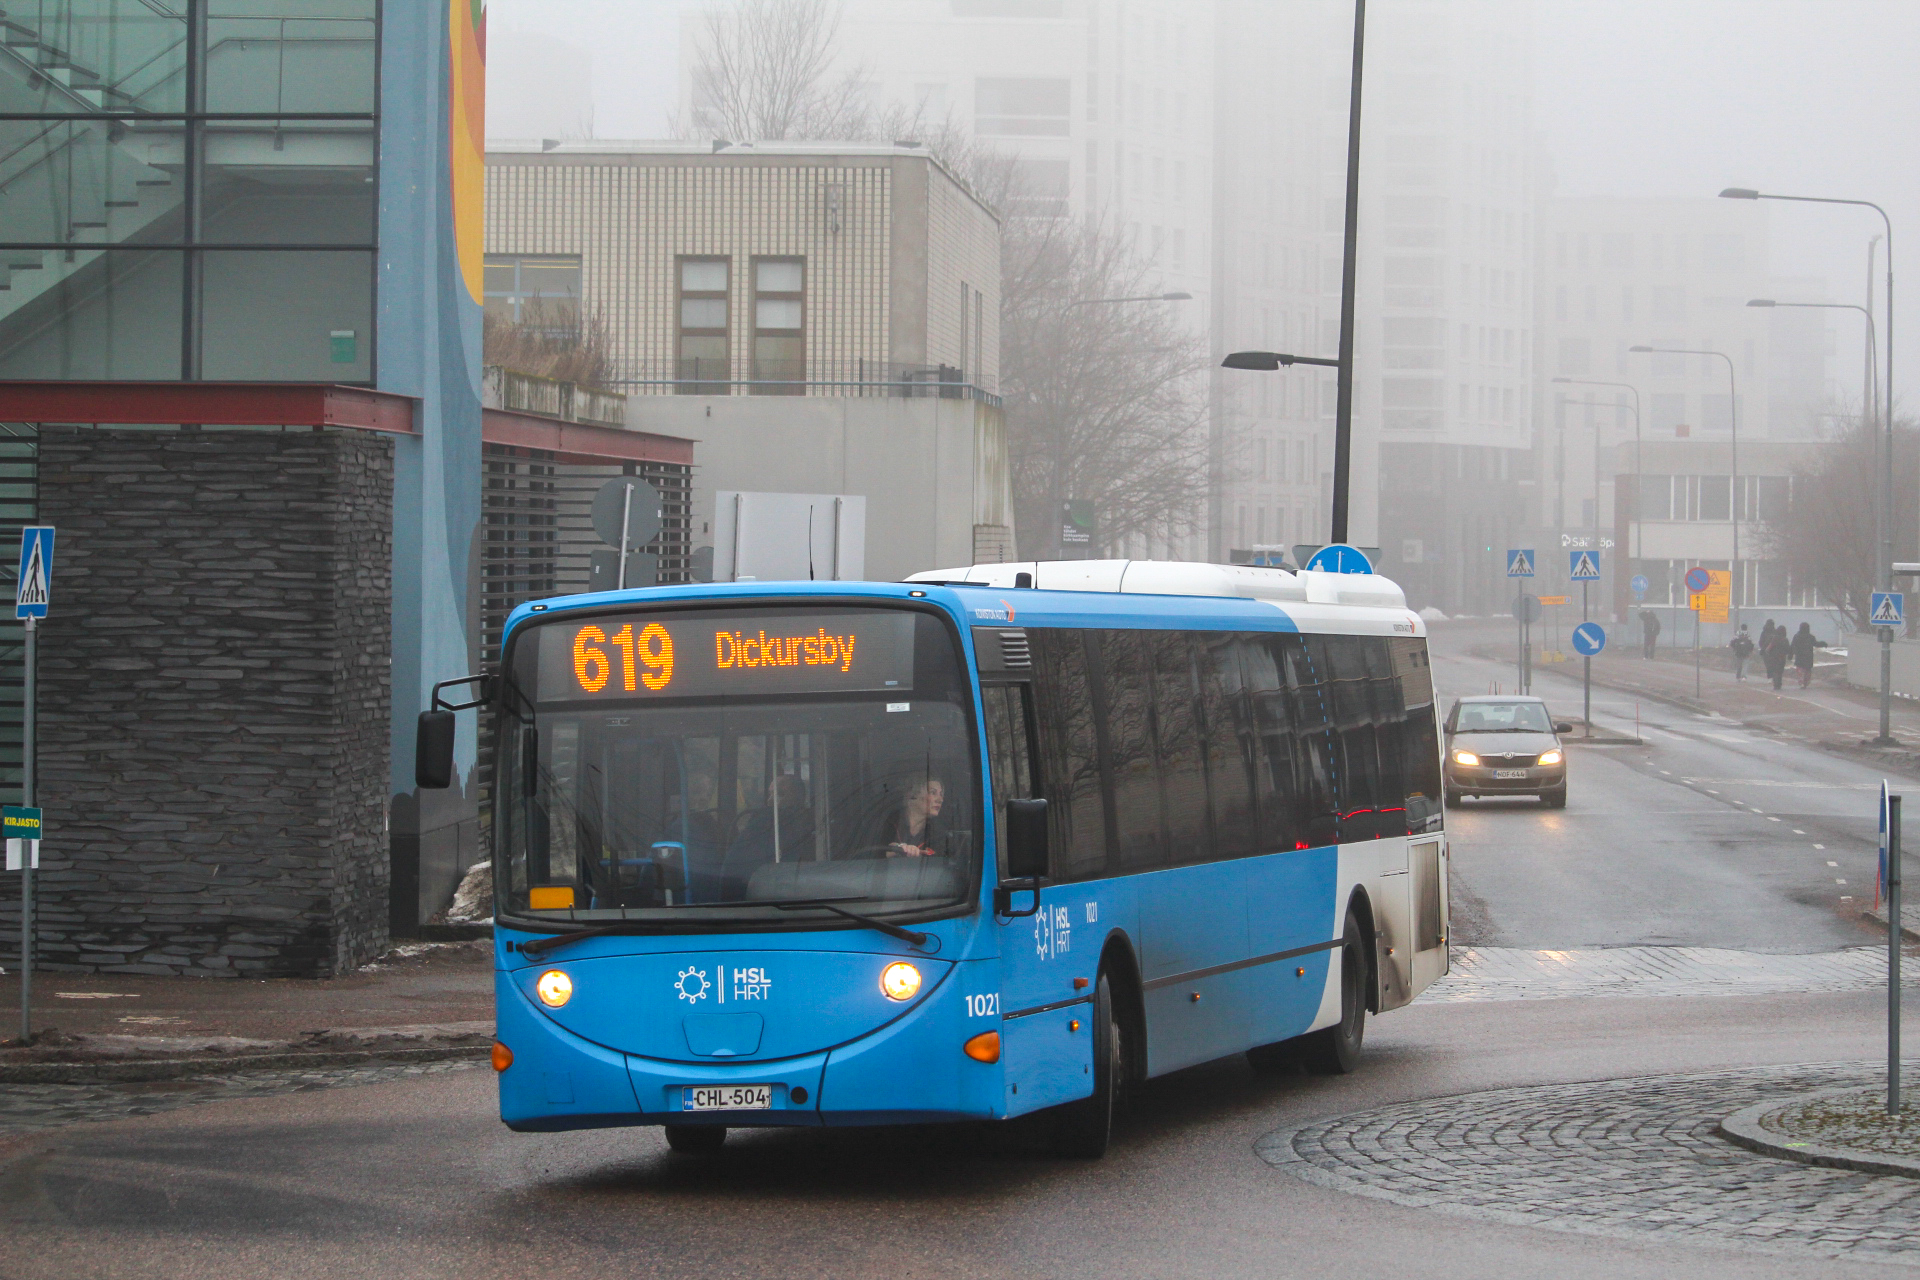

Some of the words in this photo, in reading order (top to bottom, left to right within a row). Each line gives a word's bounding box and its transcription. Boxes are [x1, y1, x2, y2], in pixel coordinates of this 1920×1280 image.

[573, 623, 675, 693] 619
[715, 627, 856, 672] Dickursby
[4, 816, 40, 828] KIRJASTO
[1055, 906, 1071, 930] HSL
[1085, 901, 1099, 924] 1021
[1056, 929, 1071, 954] HRT
[733, 967, 773, 984] HSL
[733, 984, 773, 1001] HRT
[965, 992, 1000, 1018] 1021
[696, 1088, 766, 1107] CHL-504
